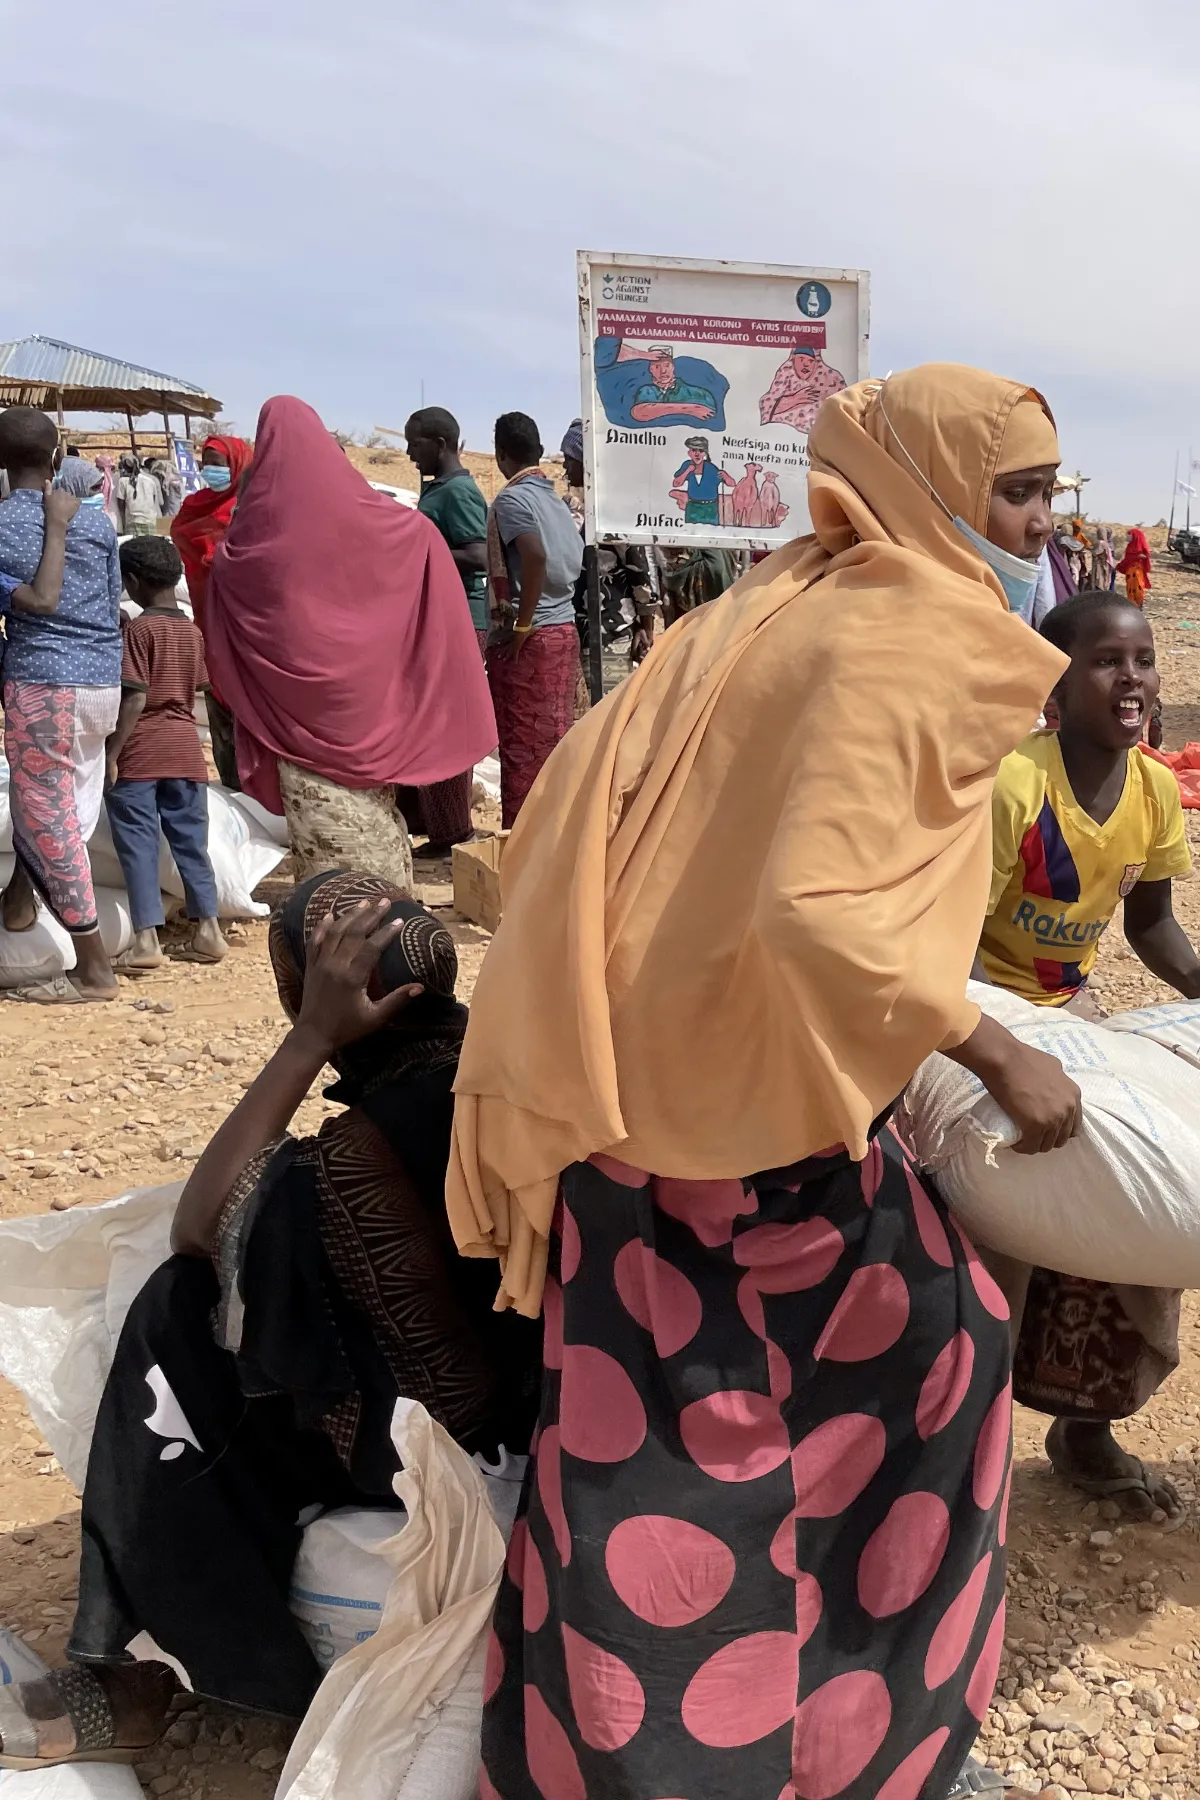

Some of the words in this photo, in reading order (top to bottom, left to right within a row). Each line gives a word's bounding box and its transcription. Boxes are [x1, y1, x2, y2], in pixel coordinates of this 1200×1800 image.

[616, 276, 651, 284] ACTION
[616, 284, 651, 294] AGAINST
[615, 293, 648, 303] HUNGER
[602, 326, 616, 334] 19)
[722, 436, 770, 451] Neefsiga
[722, 451, 744, 461] ama
